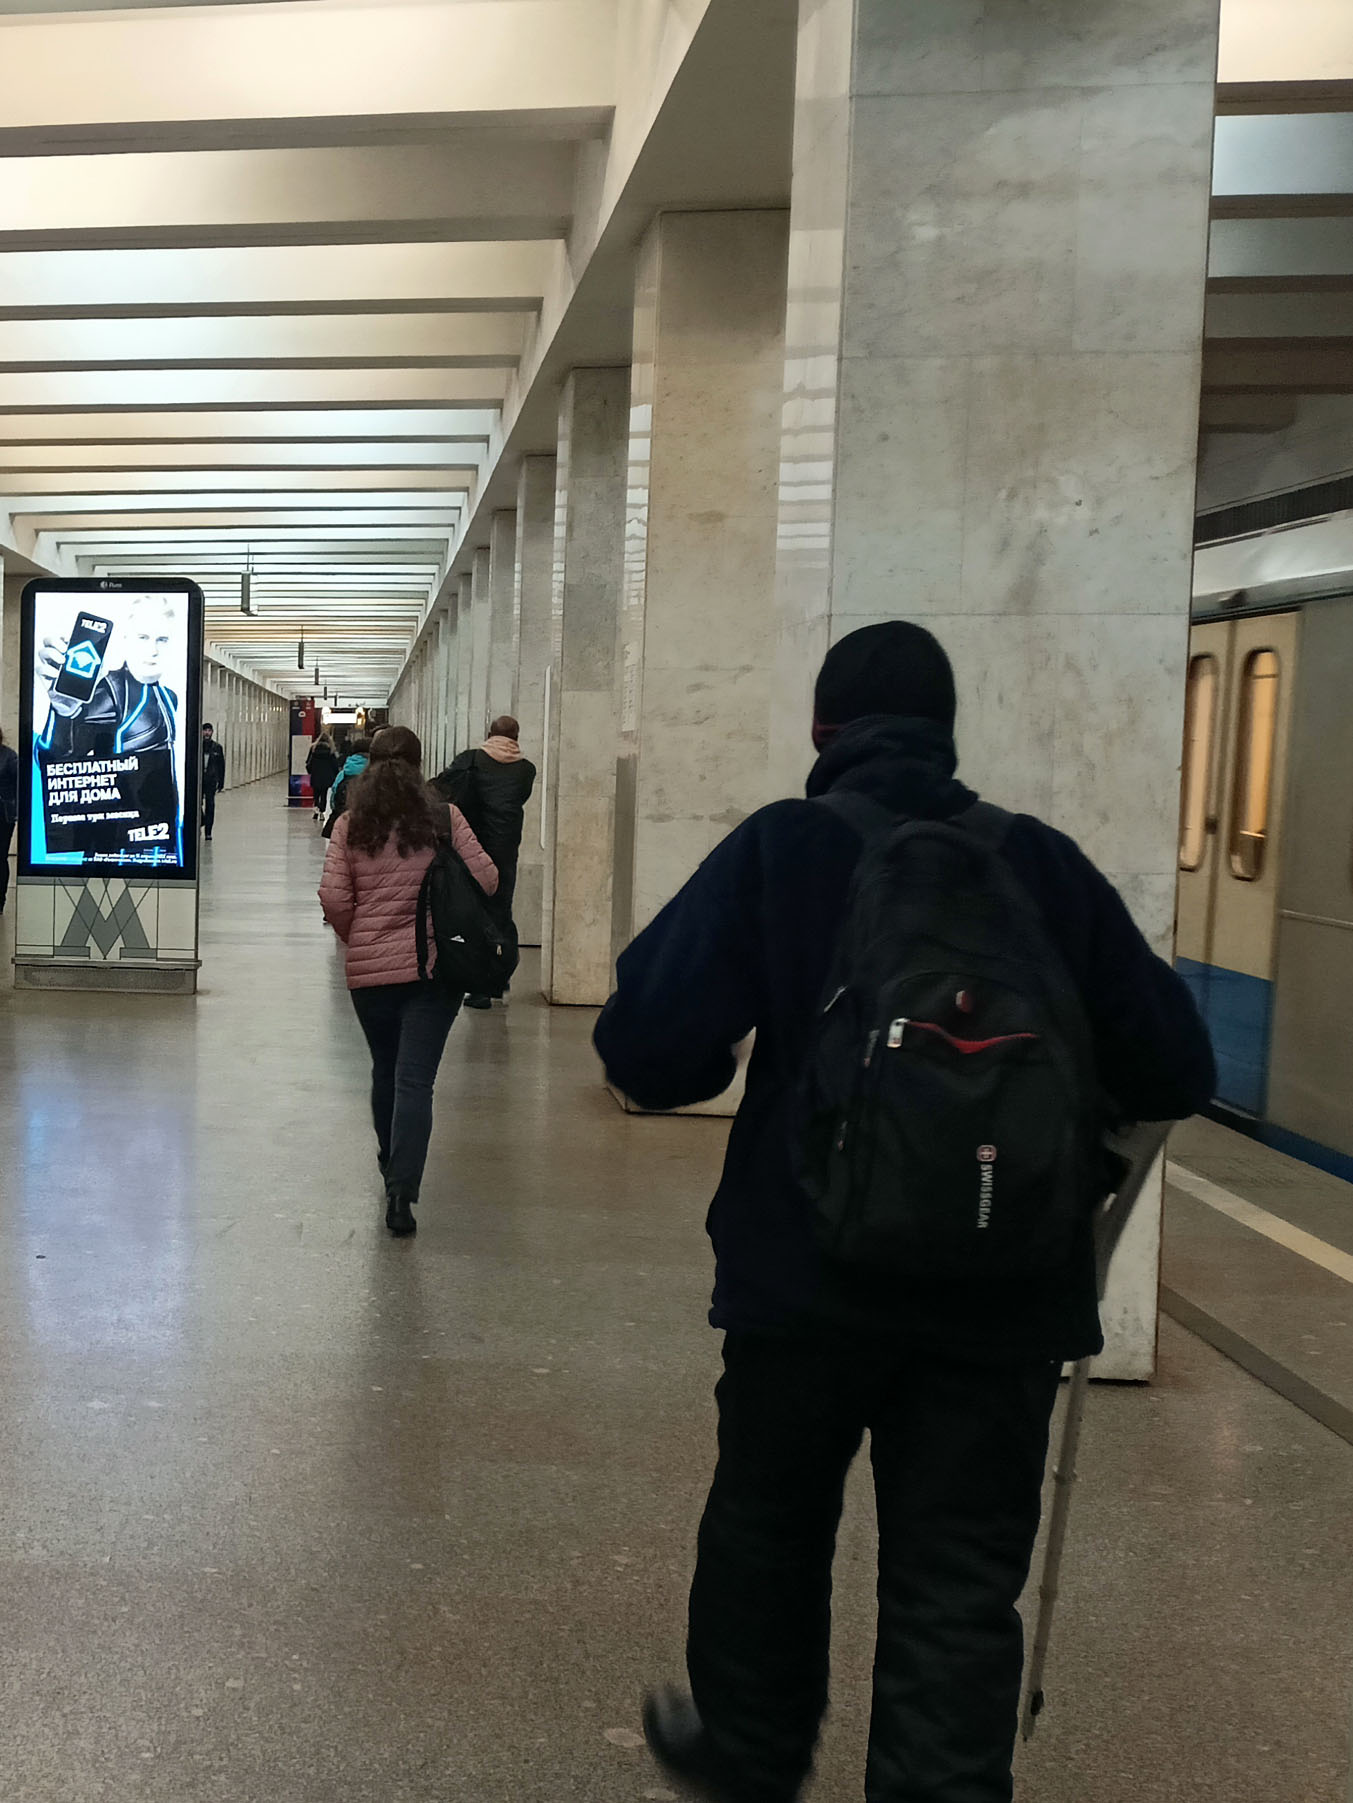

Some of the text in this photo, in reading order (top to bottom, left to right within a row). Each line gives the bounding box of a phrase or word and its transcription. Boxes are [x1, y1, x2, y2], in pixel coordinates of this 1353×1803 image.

[81, 619, 107, 633] TELE2
[47, 756, 138, 776] БЕСПЛАТНЫЙ
[48, 774, 117, 790] ИНТЕРНЕТ
[48, 788, 121, 806] ДЛЯ ДОМА
[128, 823, 169, 841] TELE2
[977, 1164, 993, 1228] SWISSGEAR
